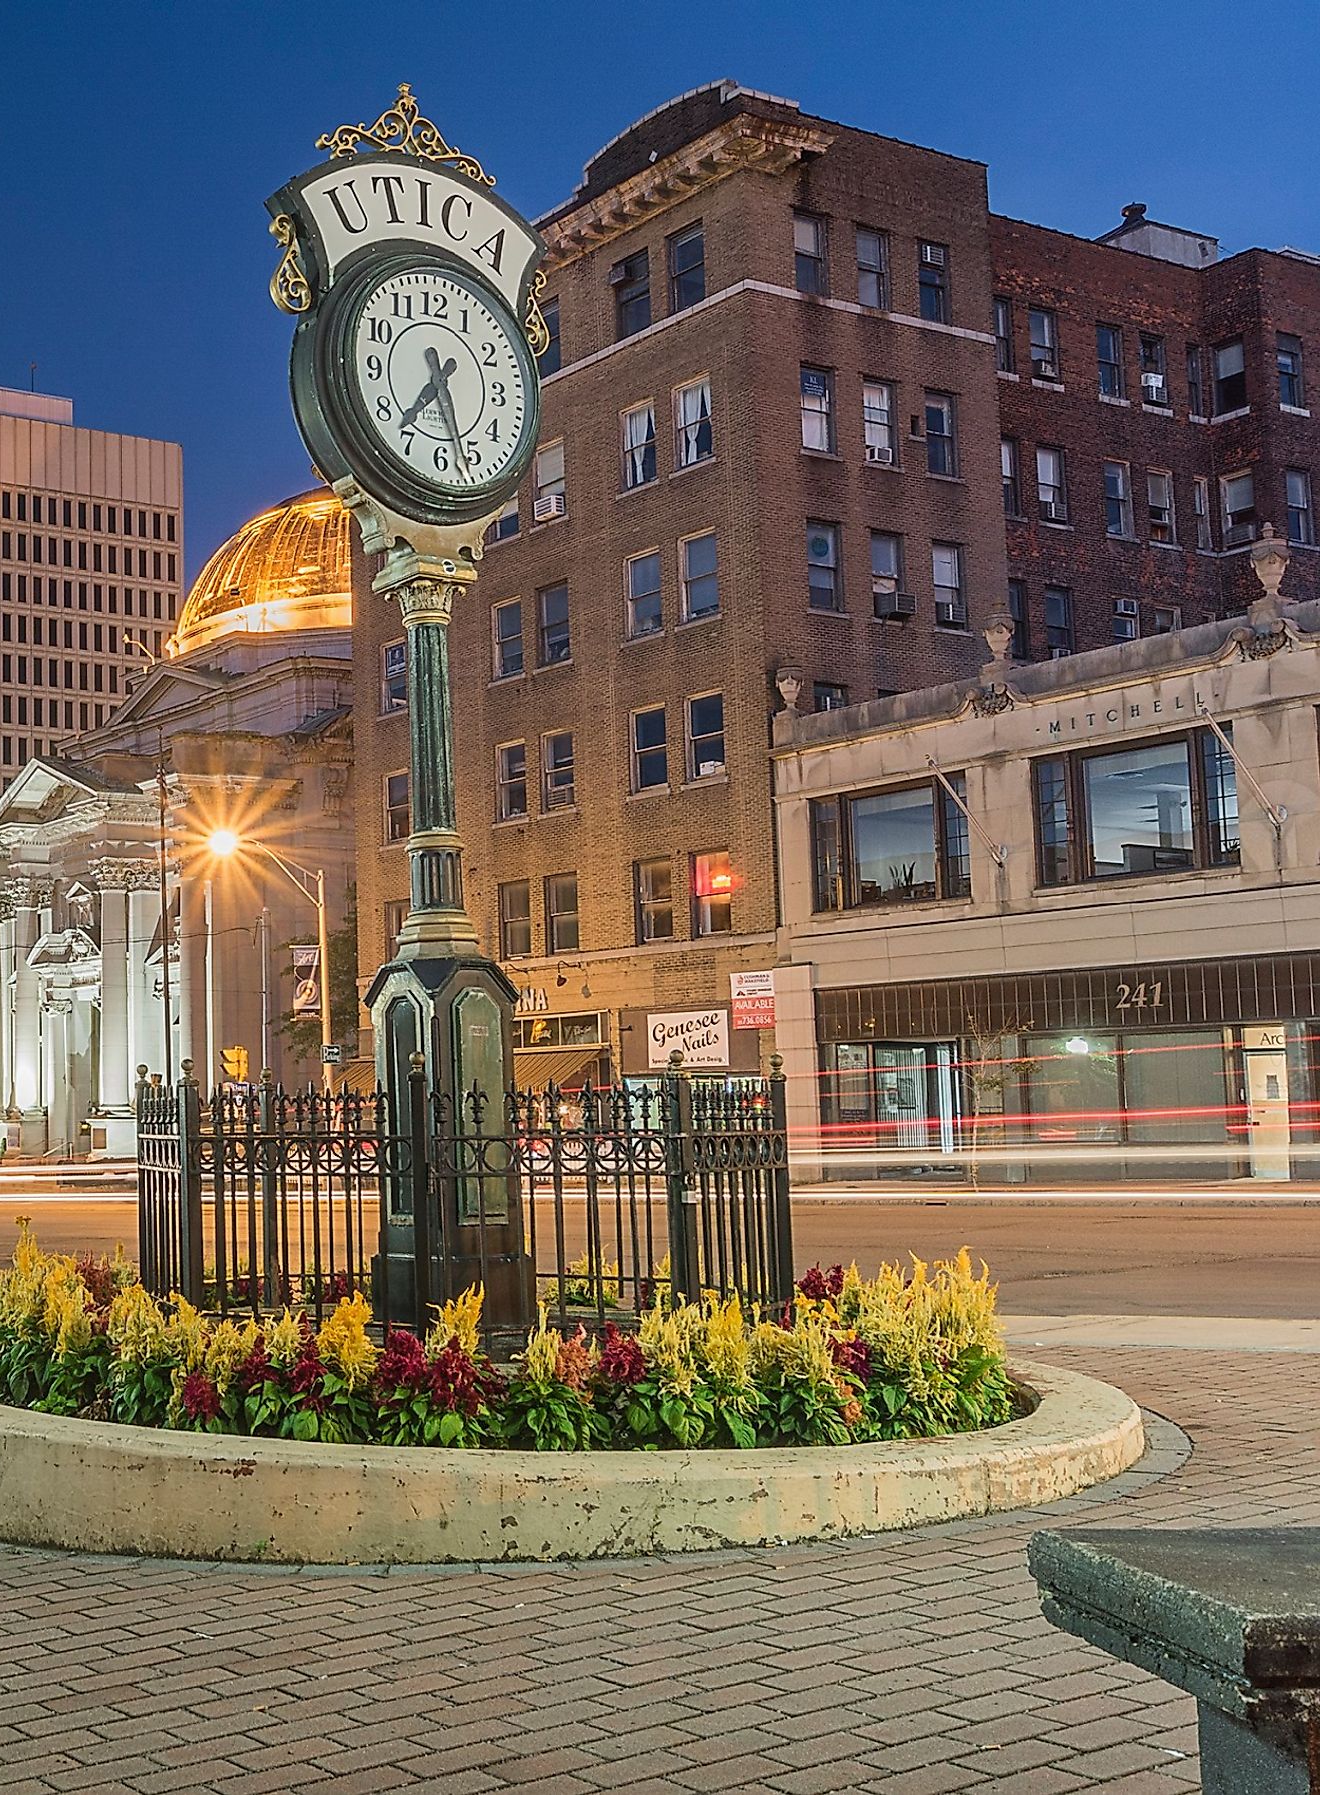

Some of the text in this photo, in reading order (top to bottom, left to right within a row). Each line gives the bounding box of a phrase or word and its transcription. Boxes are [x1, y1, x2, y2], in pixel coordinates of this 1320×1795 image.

[323, 176, 507, 276] UTICA
[389, 291, 415, 321] 11
[419, 291, 449, 320] 12
[366, 317, 393, 345] 10
[458, 309, 471, 335] 1
[366, 354, 382, 381] 9
[481, 342, 498, 368] 2
[490, 381, 506, 407] 3
[376, 395, 392, 422] 8
[399, 430, 415, 456] 7
[484, 418, 501, 443] 4
[433, 446, 449, 472] 6
[466, 440, 482, 466] 5
[1049, 691, 1205, 734] MITCHELL
[734, 999, 774, 1010] AVAILABLE
[1115, 981, 1164, 1009] 241
[652, 1012, 721, 1048] Genesee
[682, 1029, 720, 1052] Nails
